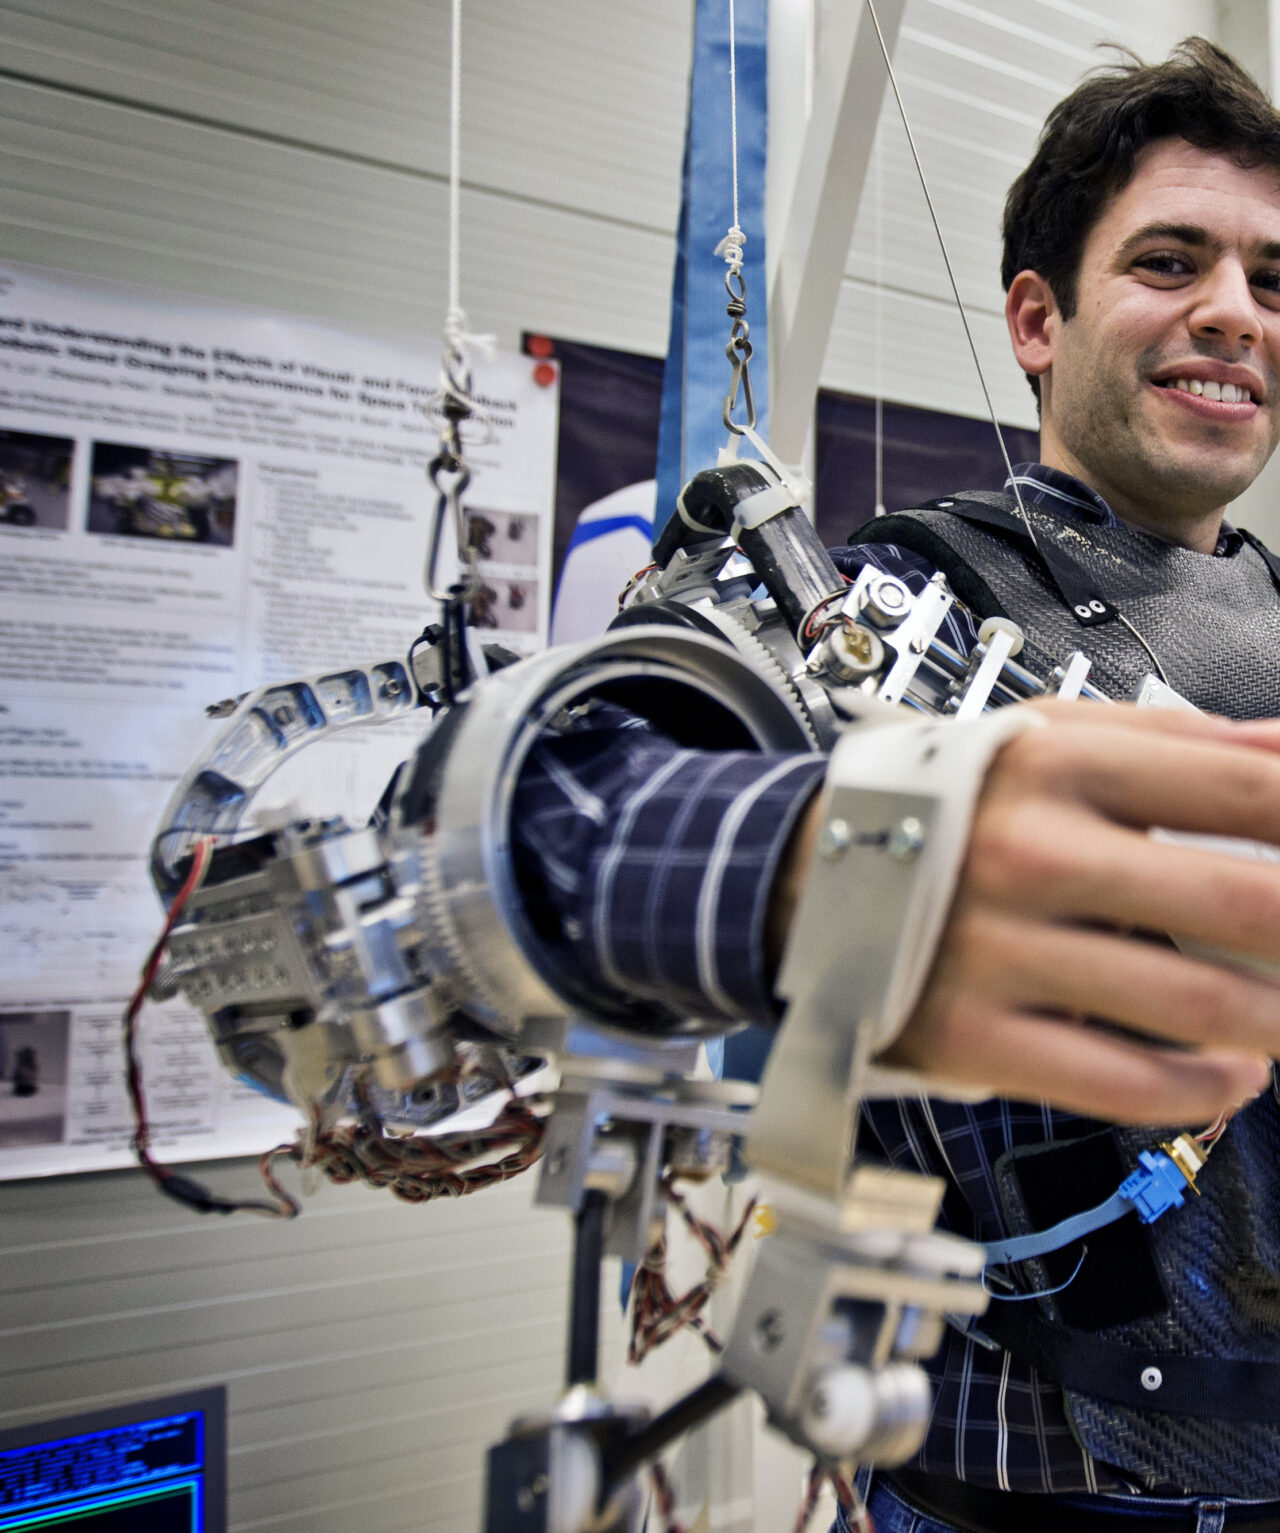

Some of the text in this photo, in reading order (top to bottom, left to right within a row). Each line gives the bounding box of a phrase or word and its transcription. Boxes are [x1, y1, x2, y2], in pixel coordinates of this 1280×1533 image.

[30, 319, 172, 358] Understanding
[177, 342, 206, 360] the
[211, 347, 274, 369] Effects
[279, 361, 295, 372] of
[362, 375, 391, 389] and
[67, 346, 118, 365] Hand
[124, 355, 208, 382] Grasping
[213, 367, 324, 397] Performance
[329, 386, 351, 400] for
[357, 391, 406, 410] Space
